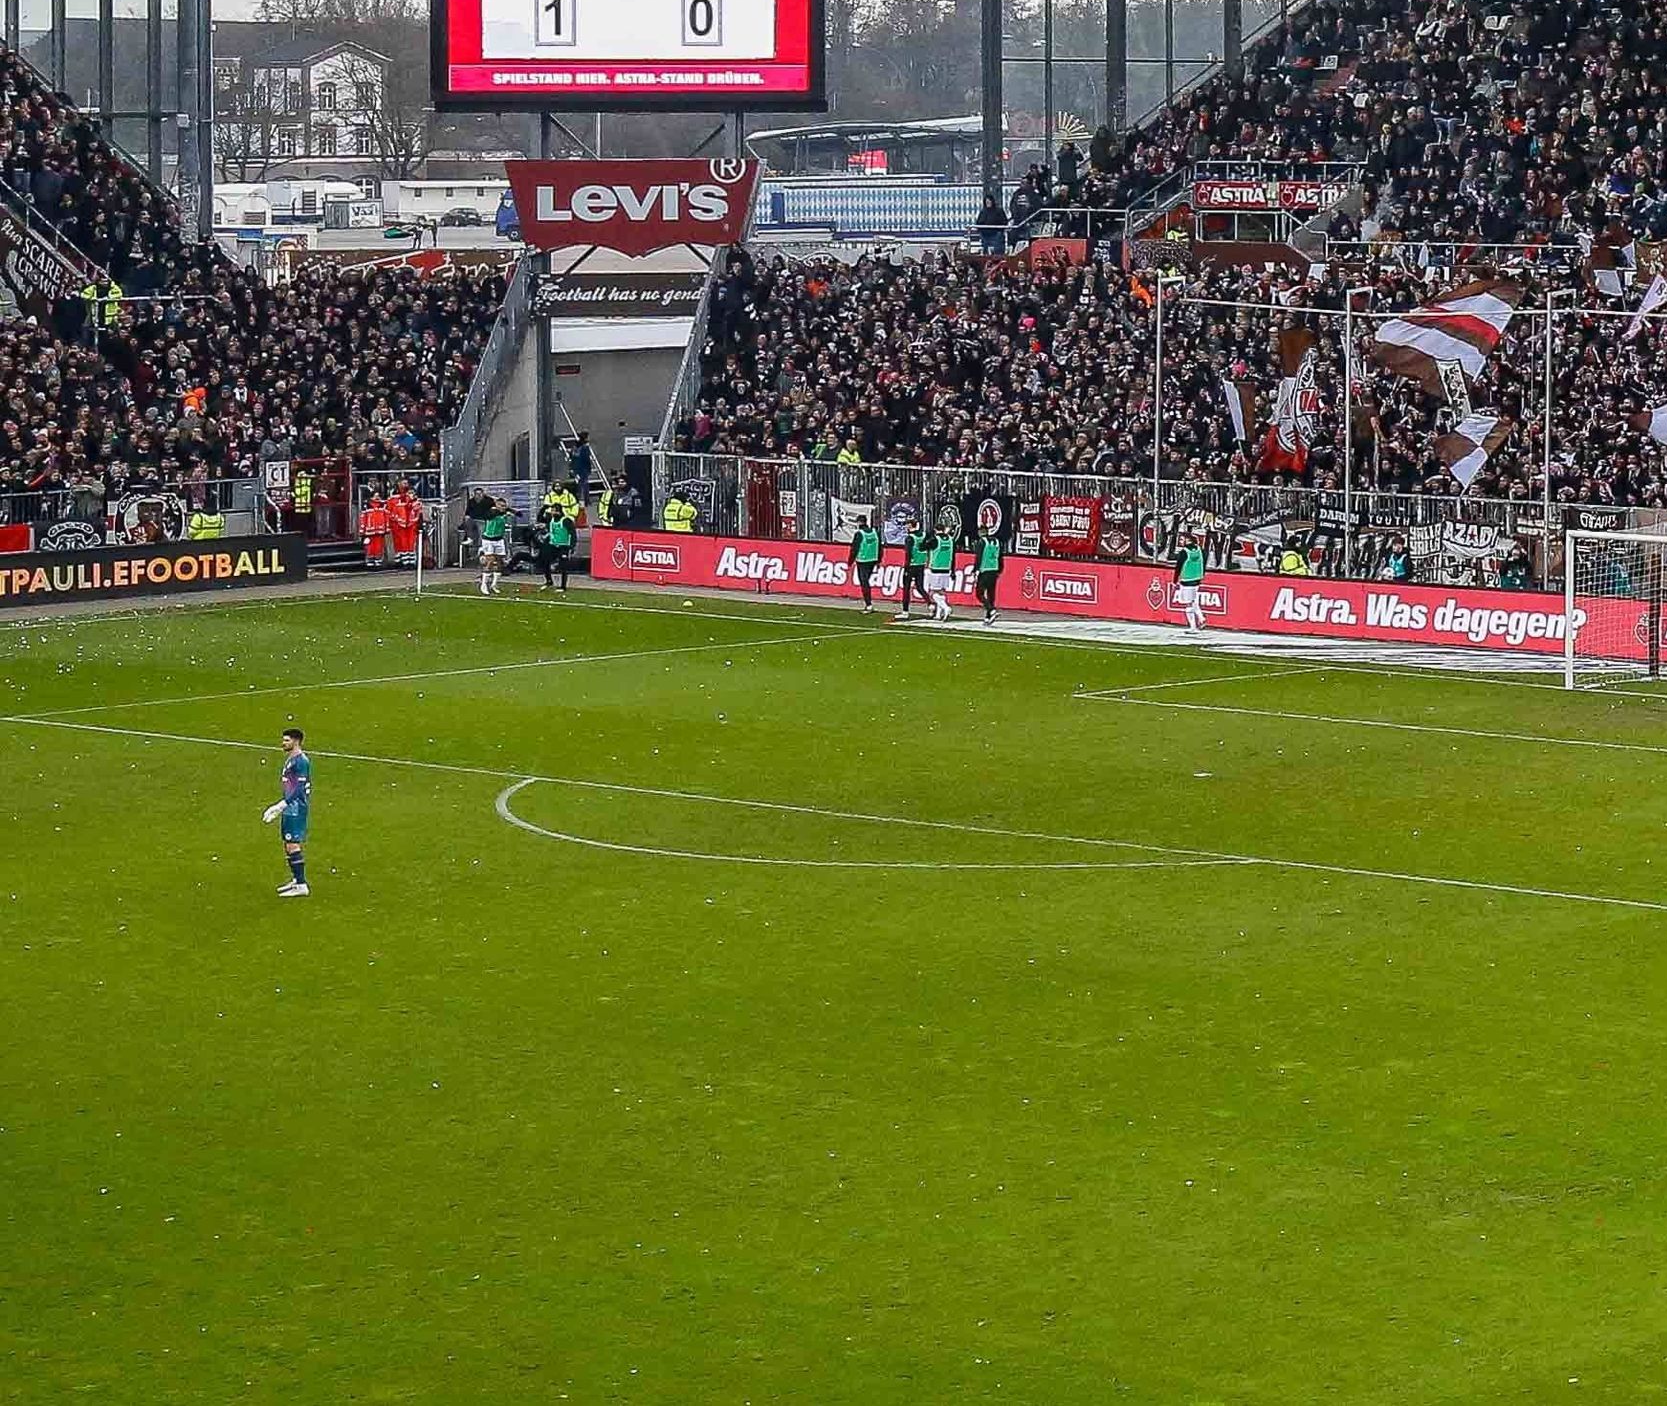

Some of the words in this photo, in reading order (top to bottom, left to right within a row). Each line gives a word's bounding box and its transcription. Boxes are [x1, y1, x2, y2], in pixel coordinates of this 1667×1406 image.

[492, 72, 573, 85] SPIELSTAND
[576, 72, 611, 85] HIER.
[614, 72, 704, 85] ASTRA-STAND
[608, 287, 636, 300] has
[640, 290, 660, 300] no
[633, 550, 676, 568] ASTRA
[715, 545, 789, 582] Astra.
[796, 551, 848, 585] Was
[1045, 577, 1093, 597] ASTRA
[1270, 587, 1357, 625] Astra.
[1366, 593, 1428, 630] Was
[1433, 598, 1588, 645] dagegen?
